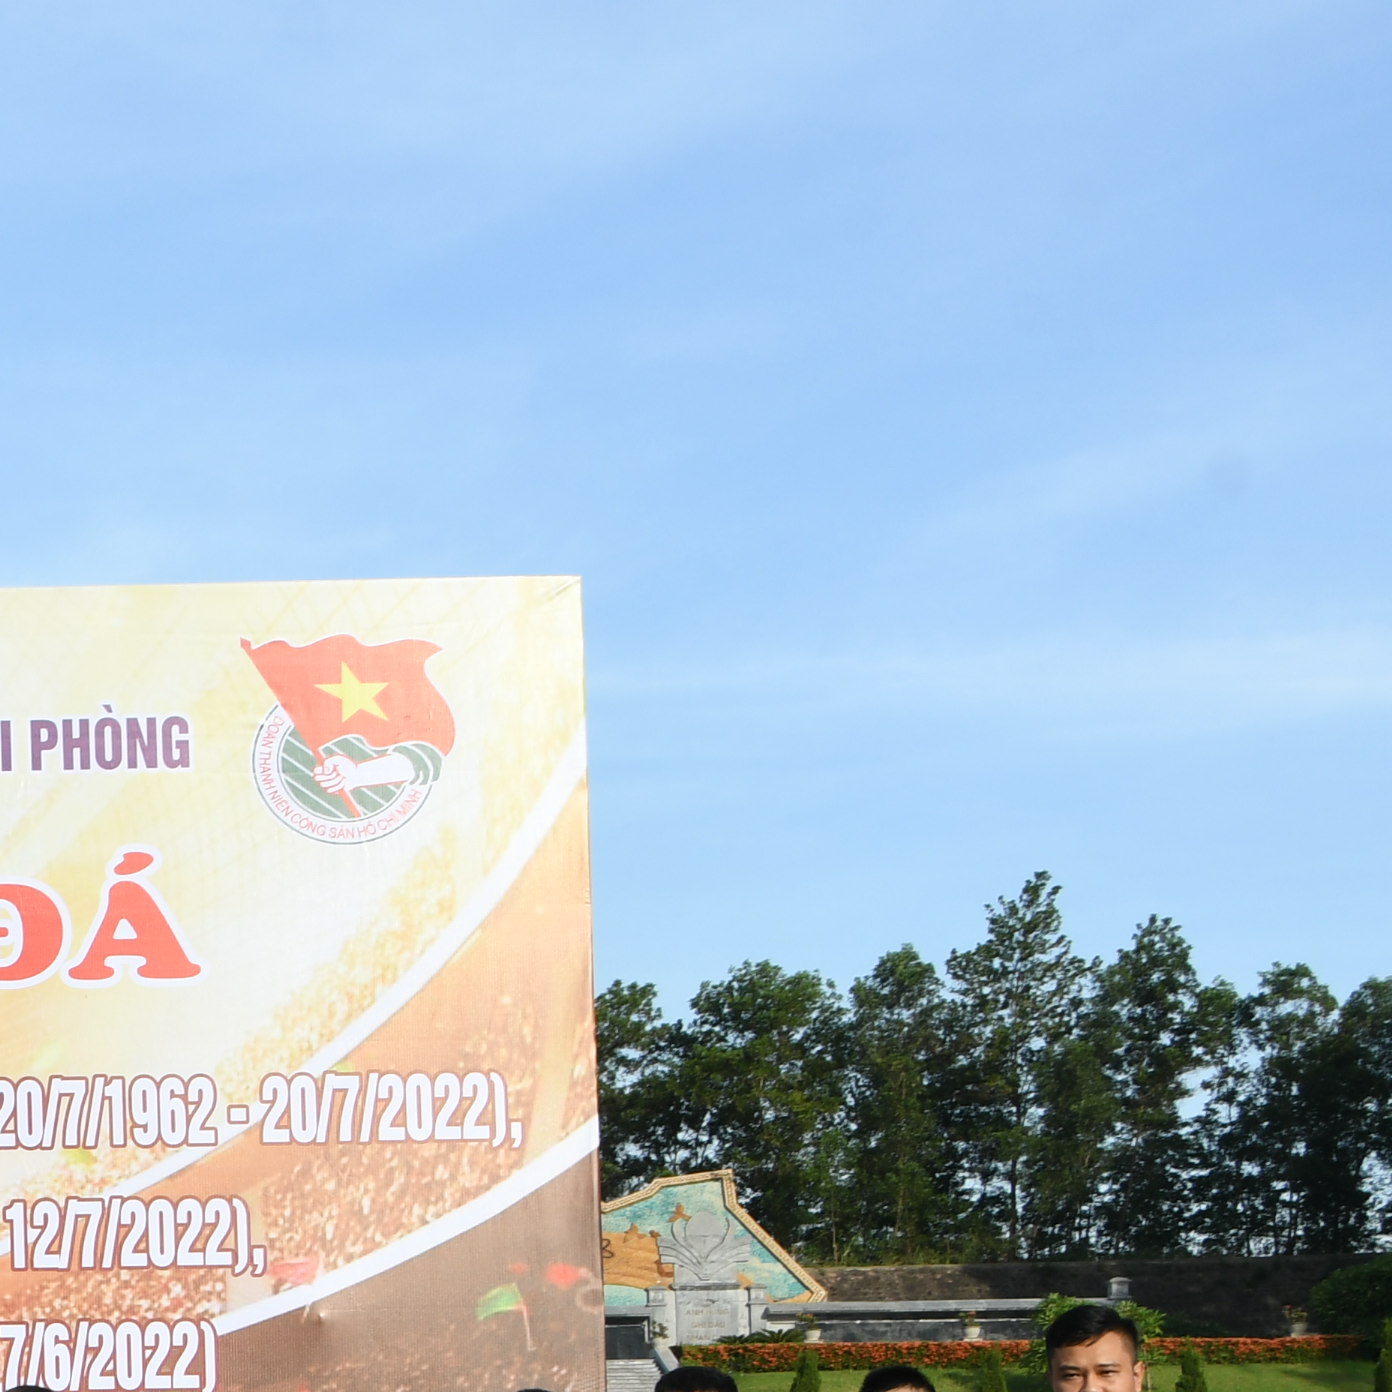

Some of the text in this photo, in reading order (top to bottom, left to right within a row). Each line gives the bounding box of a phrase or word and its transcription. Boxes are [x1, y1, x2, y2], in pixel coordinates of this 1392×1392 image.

[30, 704, 190, 772] PHÒNG
[261, 1071, 523, 1151] 20/7/2022),
[6, 1197, 266, 1277] 12/7/2022),
